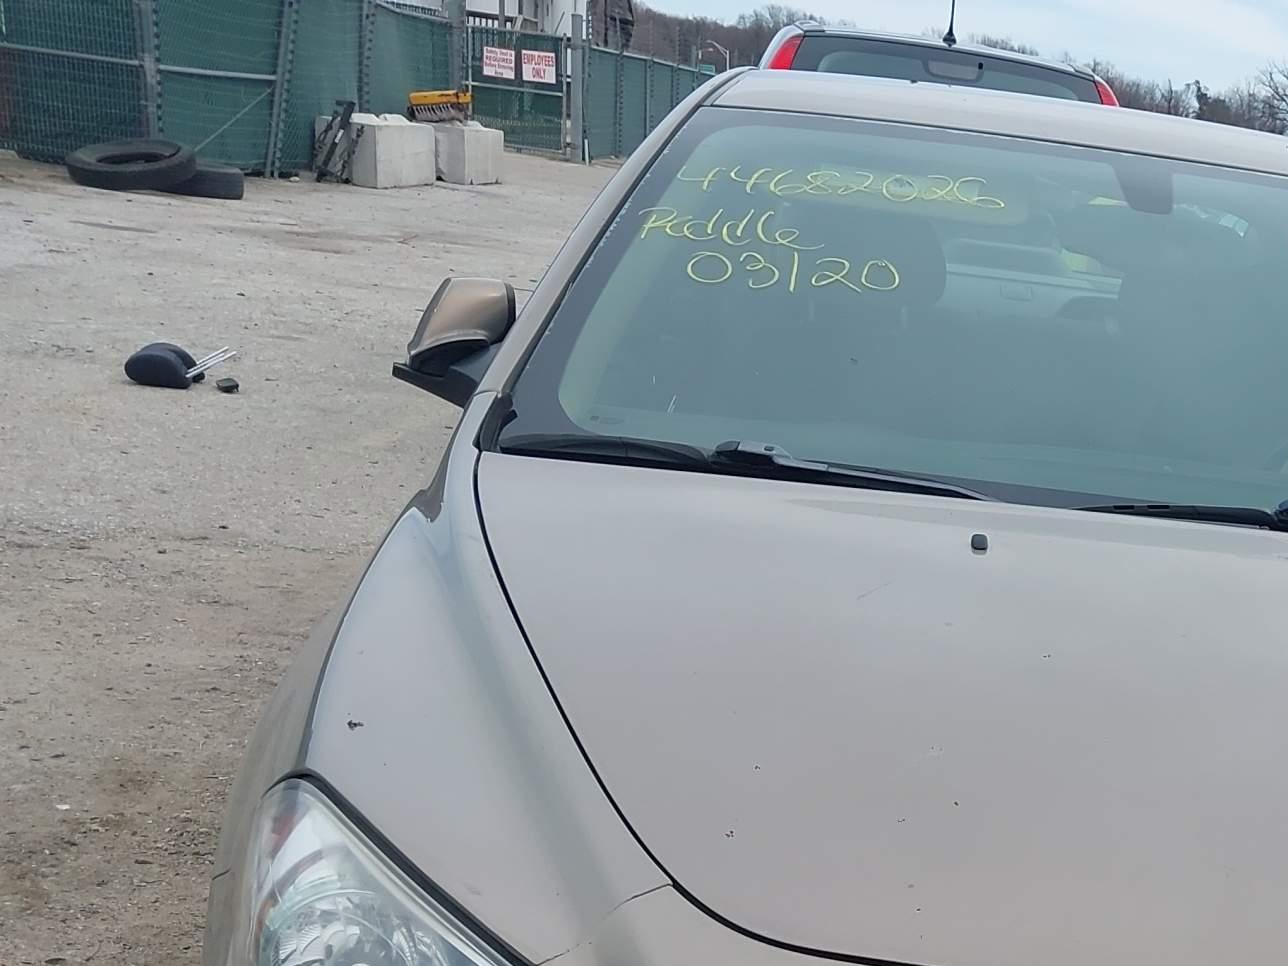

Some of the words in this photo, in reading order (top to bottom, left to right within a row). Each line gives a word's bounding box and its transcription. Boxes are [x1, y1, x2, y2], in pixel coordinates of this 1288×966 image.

[485, 54, 513, 64] REQUIRED
[523, 53, 554, 67] EMPLOYEES
[531, 66, 546, 81] ONLY
[677, 164, 1005, 208] 44682026
